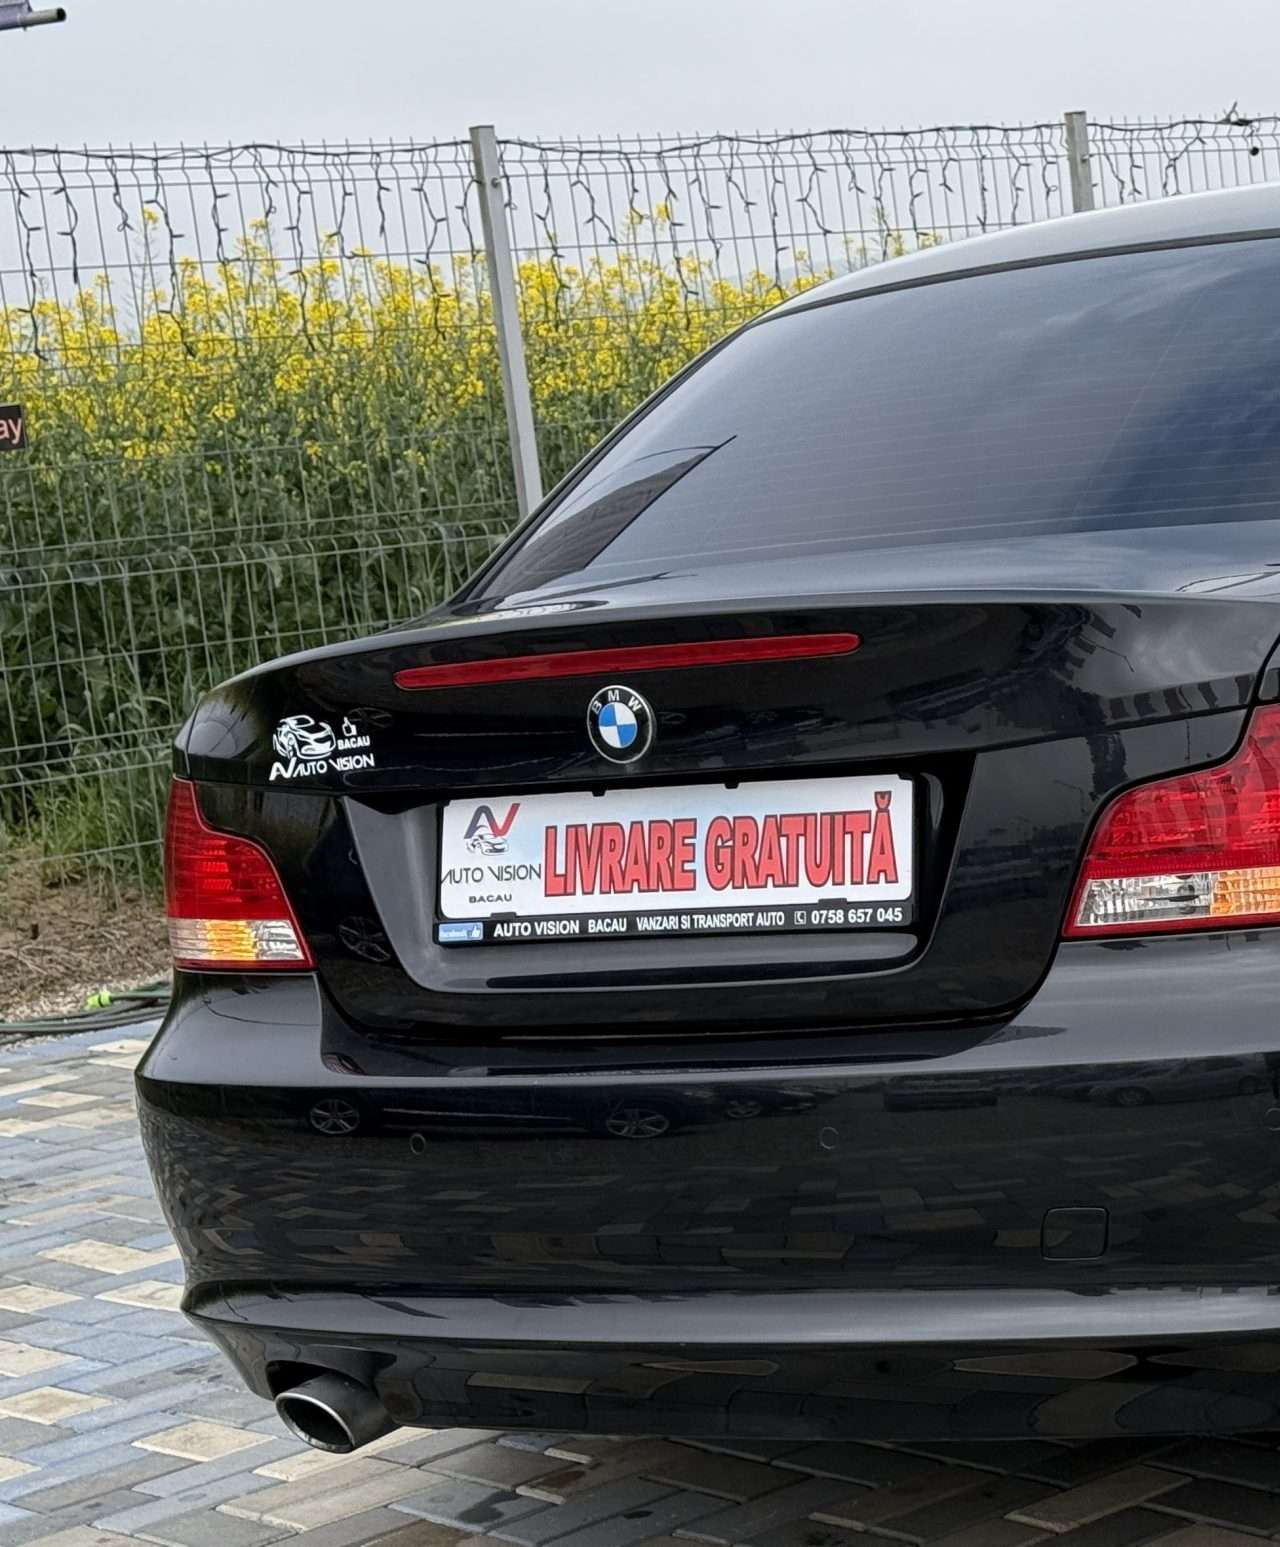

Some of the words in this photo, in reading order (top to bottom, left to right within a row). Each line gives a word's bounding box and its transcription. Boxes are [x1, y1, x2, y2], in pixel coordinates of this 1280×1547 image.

[591, 689, 642, 715] BMW
[337, 735, 371, 750] BACAU
[329, 753, 375, 772] VISION
[545, 818, 698, 897] LIVRARE
[704, 791, 899, 891] GRATUITĂ
[441, 866, 485, 884] AUTO
[487, 863, 541, 882] VISION
[468, 893, 513, 904] BACAU
[493, 922, 532, 937] AUTO
[534, 919, 580, 935] VISION
[587, 917, 628, 933] BACAU
[636, 915, 679, 931] VANZARI
[680, 914, 691, 929] SI
[692, 912, 754, 929] TRANSPORT
[756, 911, 785, 926] AUTO
[810, 909, 845, 925] 0758
[847, 908, 873, 923] 657
[876, 907, 903, 922] 045
